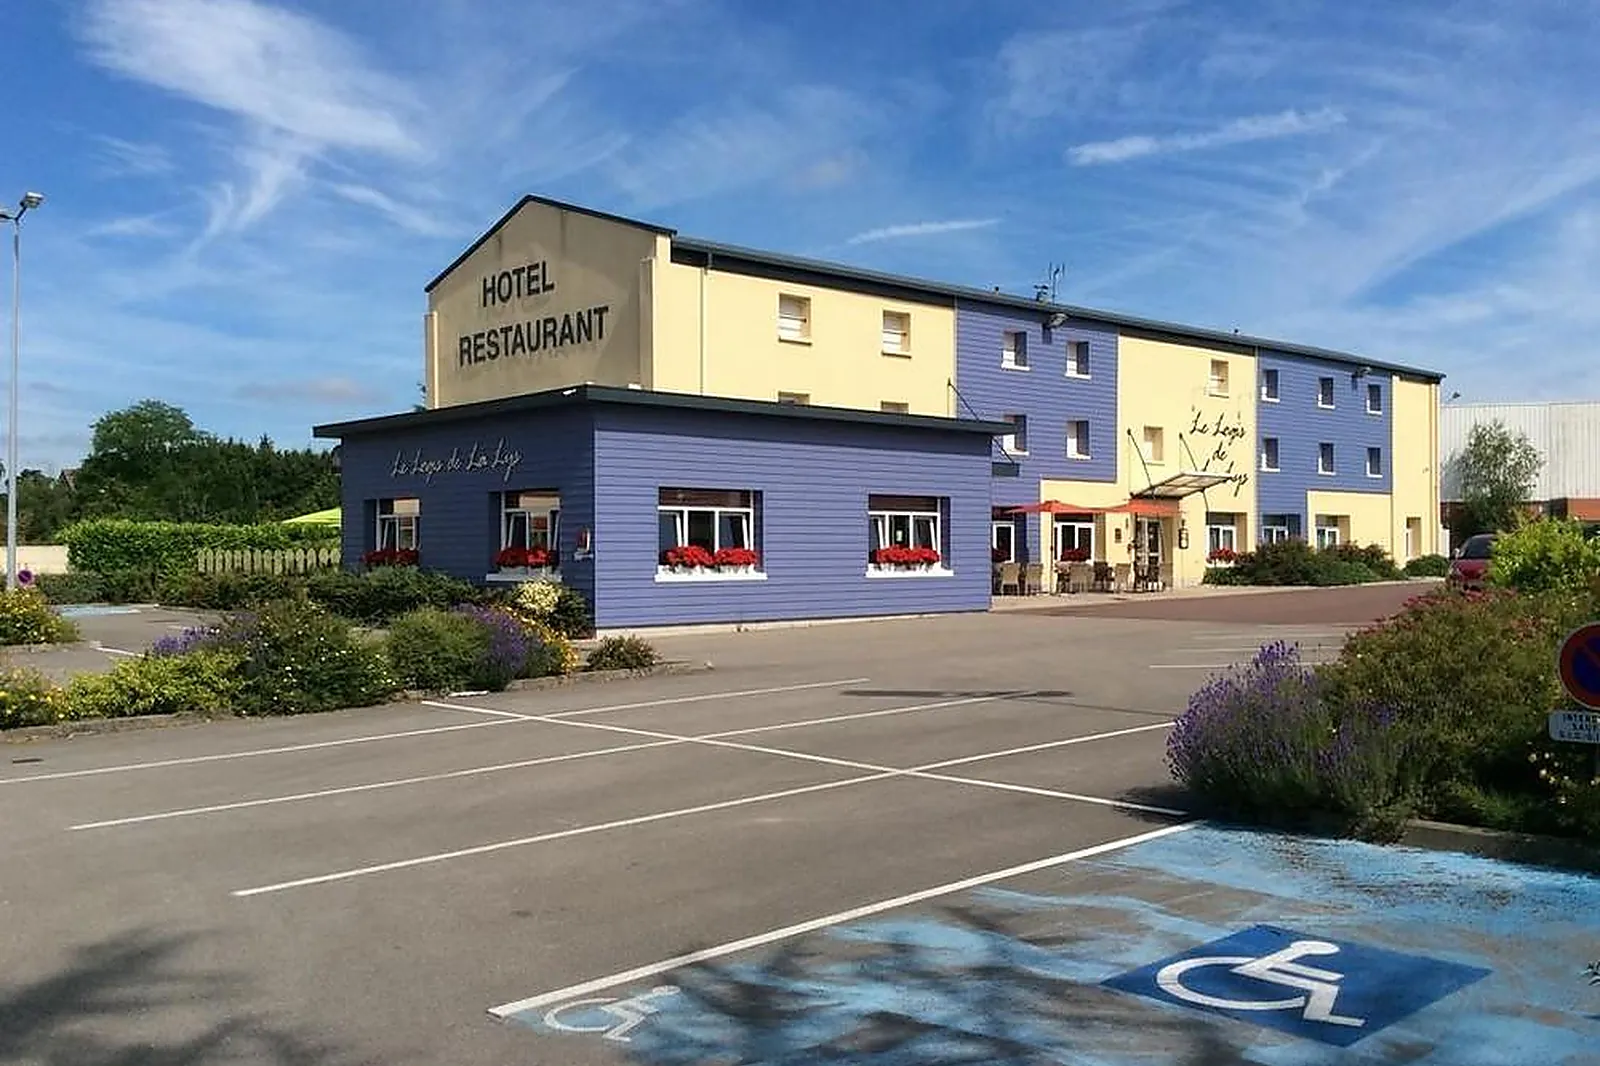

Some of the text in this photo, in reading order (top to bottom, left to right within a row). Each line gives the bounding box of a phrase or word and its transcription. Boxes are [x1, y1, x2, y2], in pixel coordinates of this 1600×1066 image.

[482, 261, 555, 307] HOTEL
[459, 306, 609, 367] RESTAURANT
[1190, 411, 1208, 434] Le
[390, 449, 409, 477] Le
[447, 447, 462, 470] de
[1212, 441, 1227, 461] de
